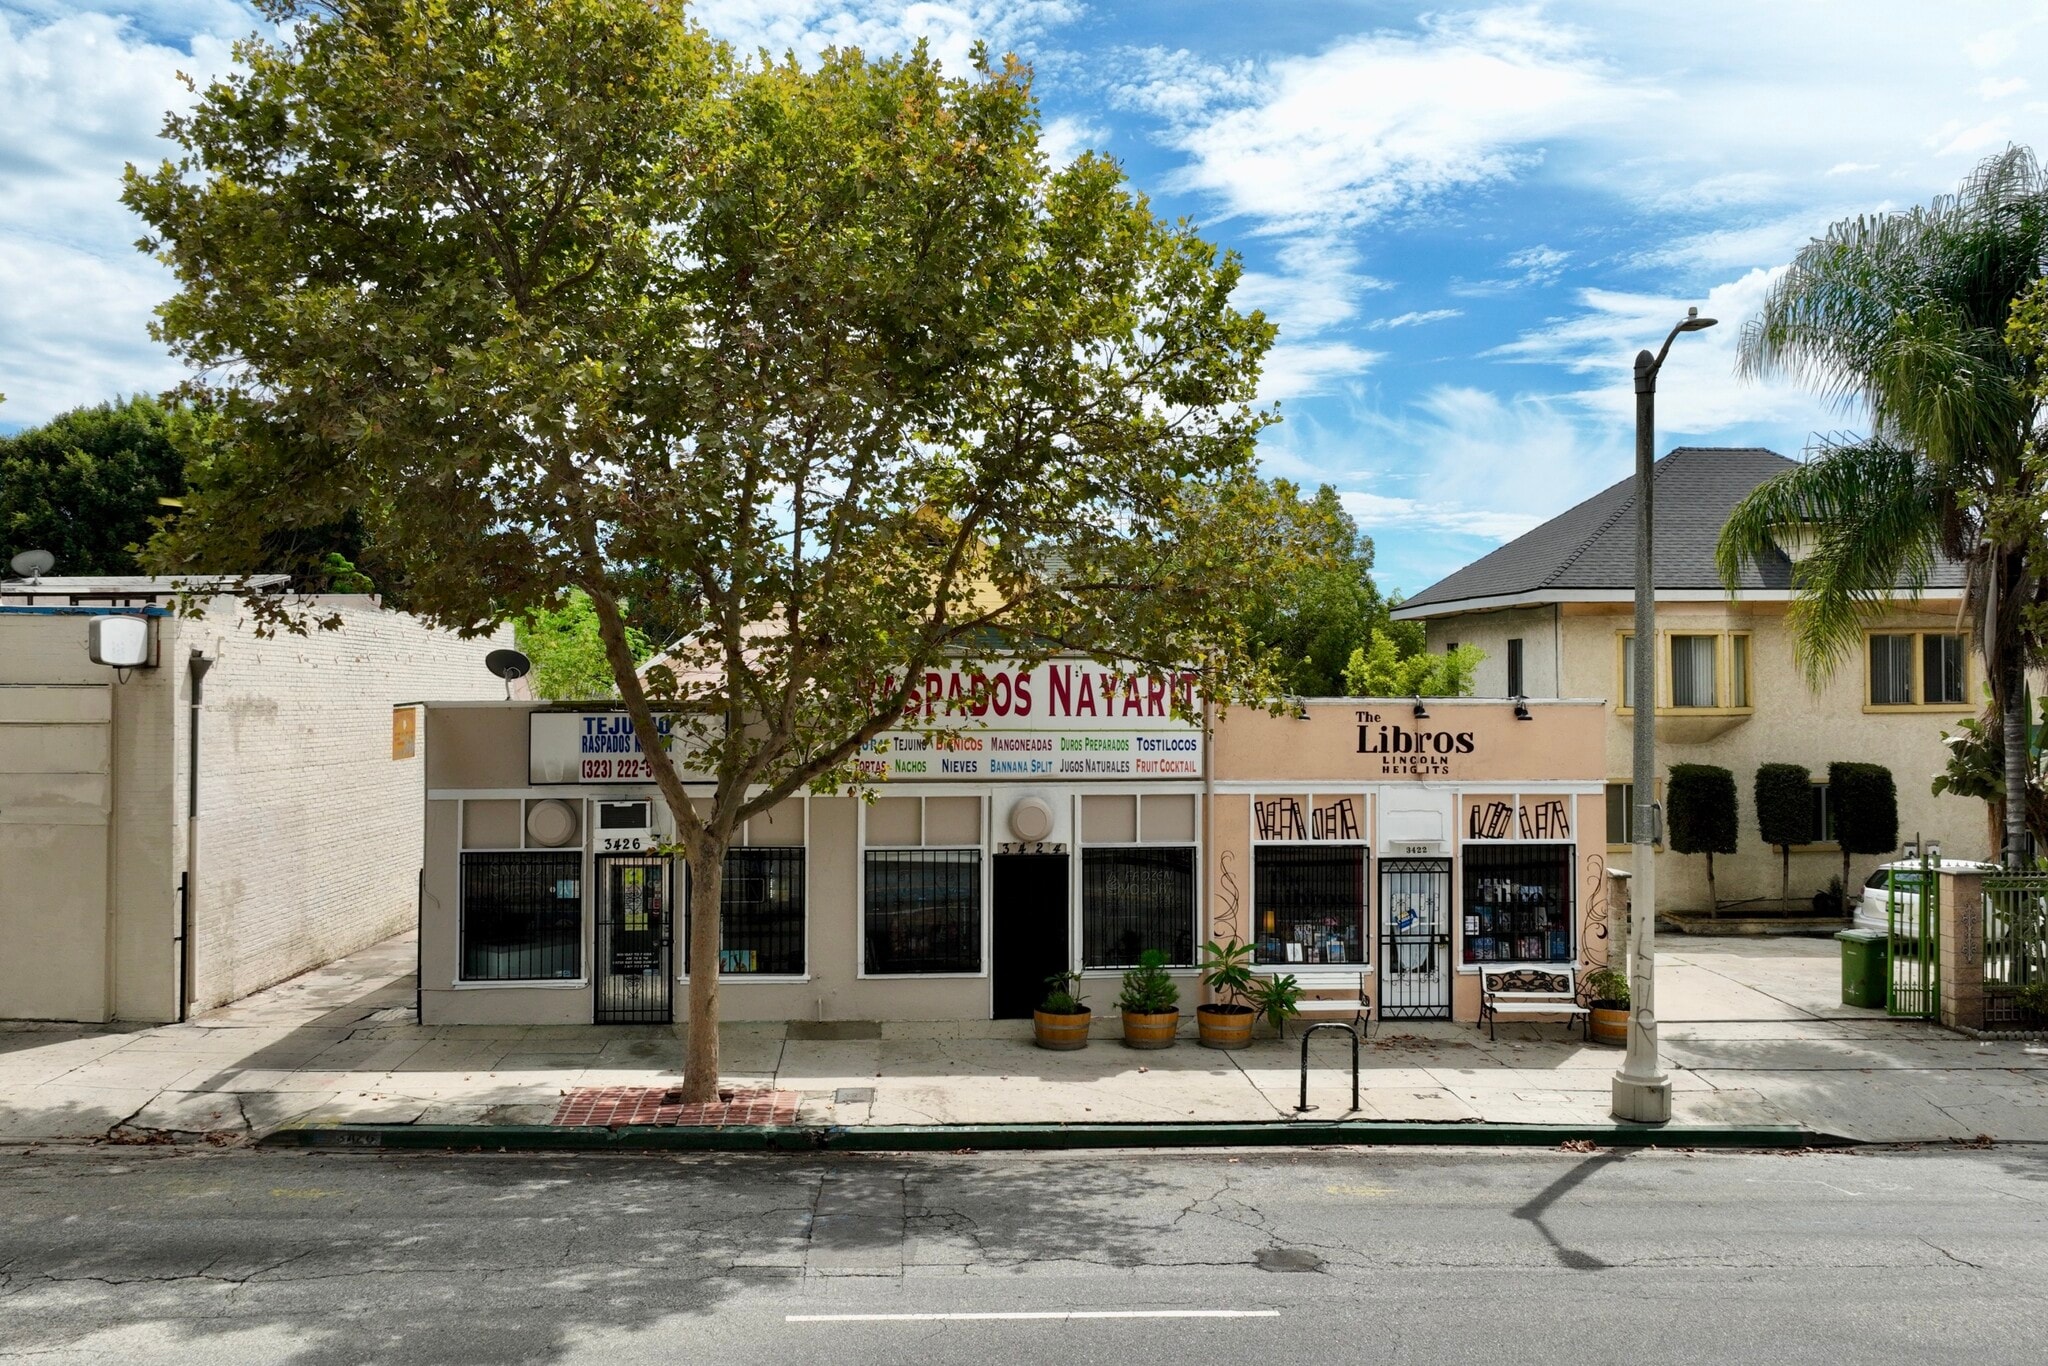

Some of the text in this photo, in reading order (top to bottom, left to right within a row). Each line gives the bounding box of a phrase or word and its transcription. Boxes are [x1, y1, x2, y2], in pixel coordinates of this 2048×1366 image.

[858, 665, 1199, 717] SPADOS NAYARIT
[1355, 711, 1381, 723] The
[583, 717, 670, 735] TEJUO
[582, 735, 631, 753] RASPADOS
[936, 737, 983, 751] BINICOS
[991, 737, 1053, 751] MANGONEADAS
[1060, 737, 1083, 751] DUROS
[1084, 737, 1130, 751] PREPARADOS
[1136, 737, 1197, 751] TOSTILOCOS
[1356, 725, 1475, 754] Libros
[854, 758, 1197, 774] TORTAS NACHOS NIEVES BANNANA SPLIT JUGOS NATURALES FRUIT COCKTAIL
[1382, 756, 1449, 765] LINCOLN
[582, 759, 674, 779] (323) 222-5
[604, 837, 641, 851] 3426
[1002, 842, 1062, 855] 3424
[1405, 846, 1428, 854] 3422
